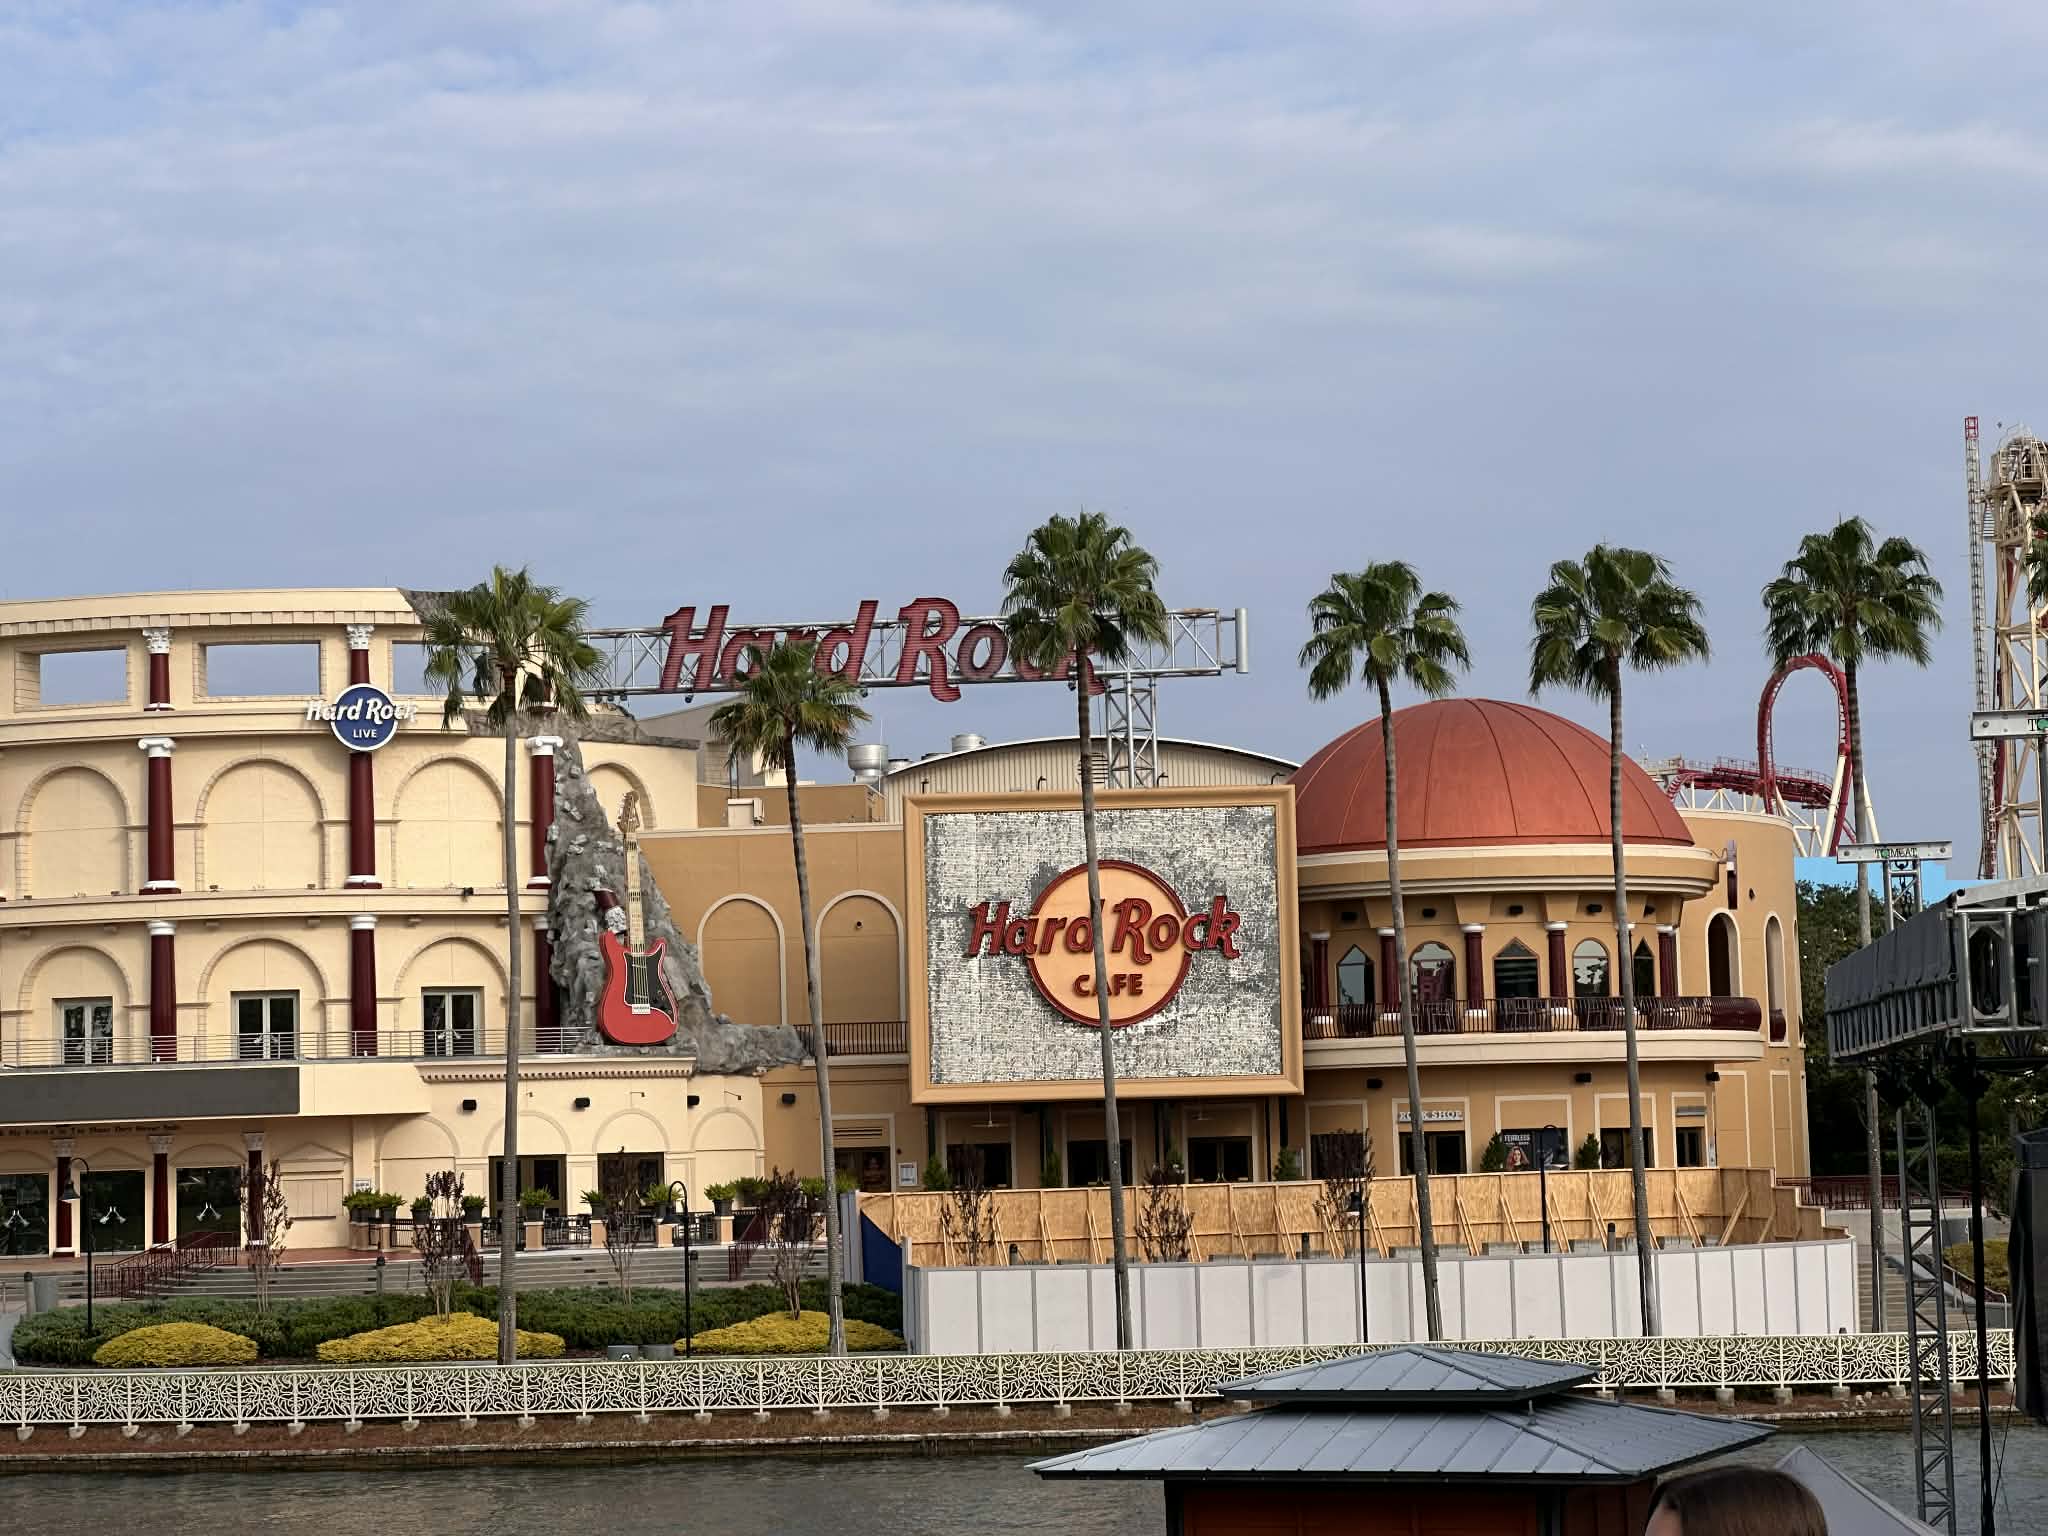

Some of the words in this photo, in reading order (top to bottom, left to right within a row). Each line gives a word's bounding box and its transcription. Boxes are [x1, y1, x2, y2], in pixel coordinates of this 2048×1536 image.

[895, 596, 1106, 703] Ro
[305, 697, 364, 721] Hard
[365, 697, 418, 725] Rock
[352, 729, 378, 739] LIVE
[1111, 895, 1241, 965] Rock
[1399, 1111, 1430, 1121] RK
[1431, 1110, 1464, 1121] SHOP
